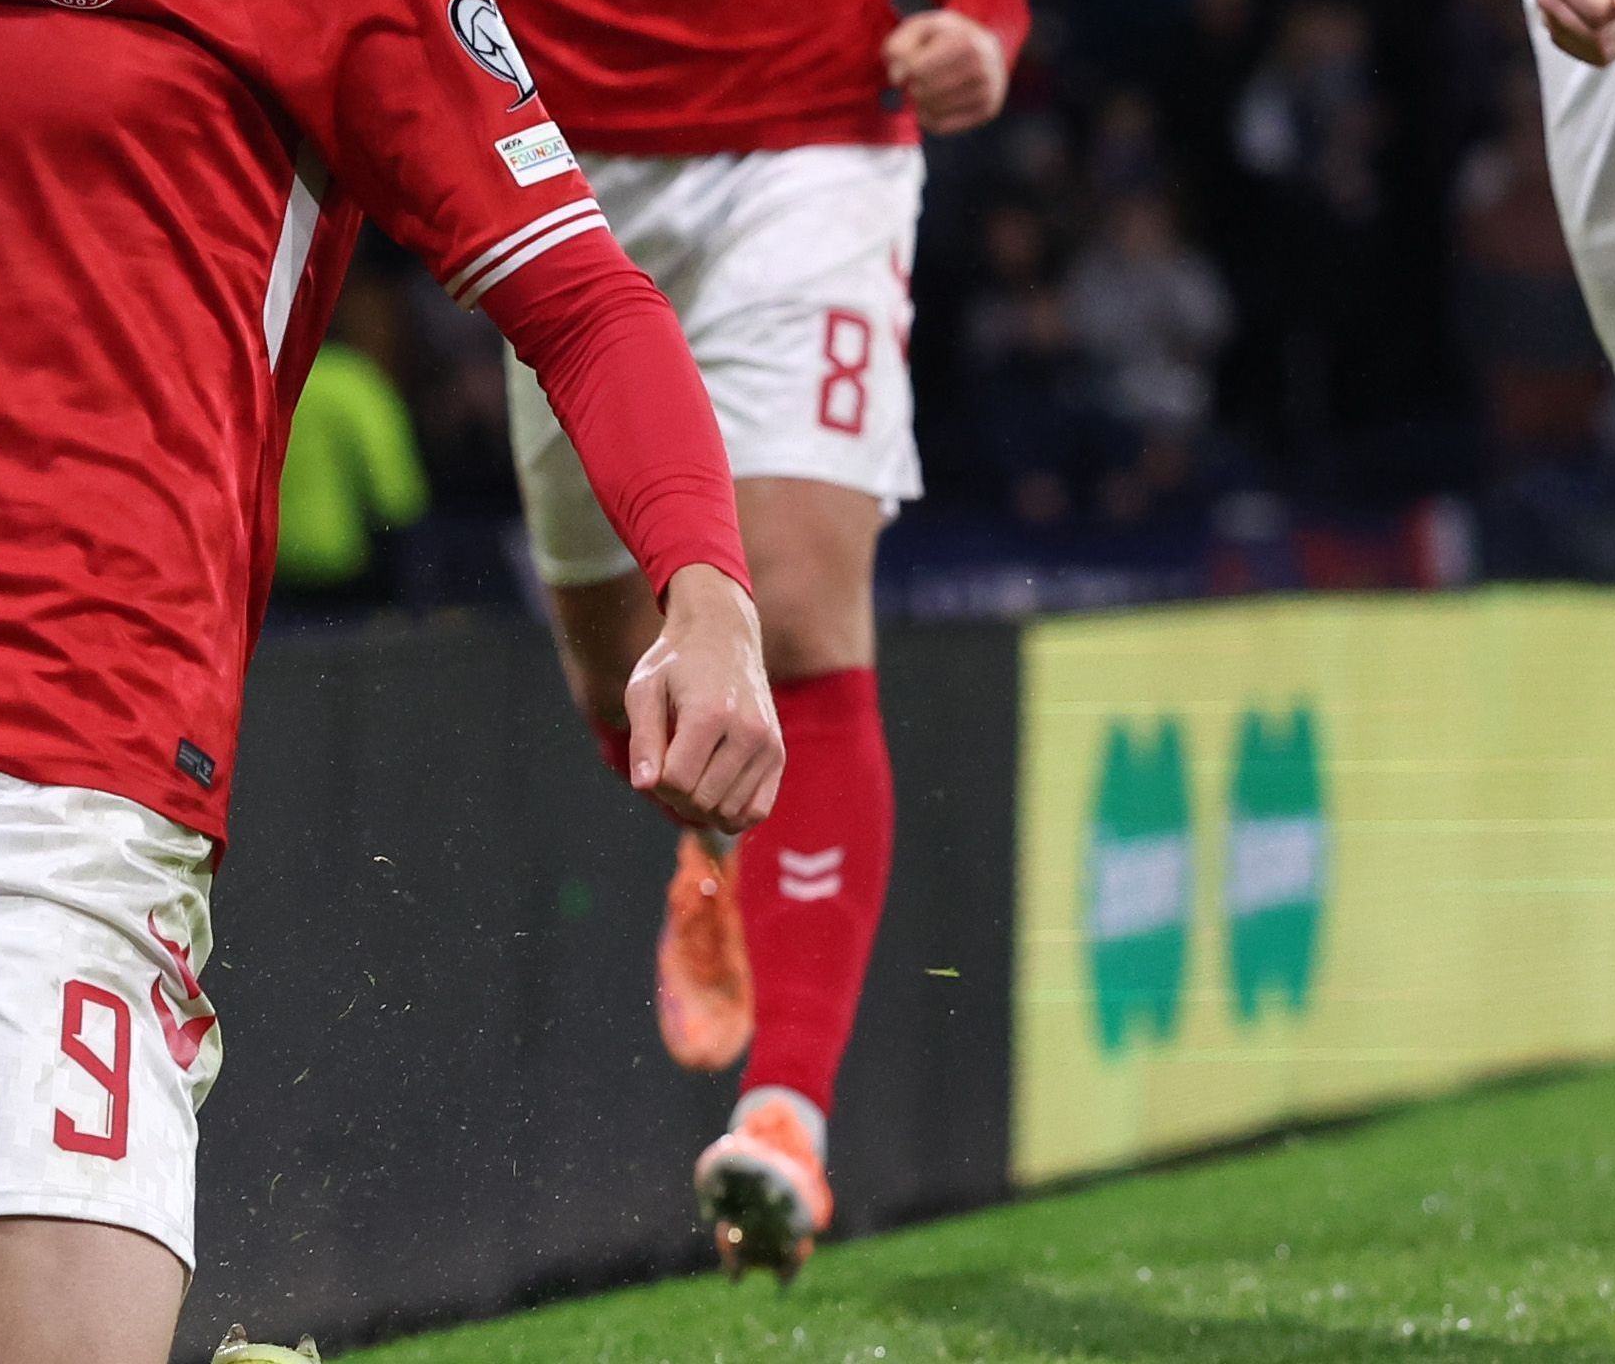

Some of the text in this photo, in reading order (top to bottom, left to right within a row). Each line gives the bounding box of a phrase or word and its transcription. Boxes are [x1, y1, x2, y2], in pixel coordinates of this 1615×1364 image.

[508, 140, 565, 168] FOUNDAT
[819, 308, 871, 437] 8
[53, 979, 131, 1161] 9
